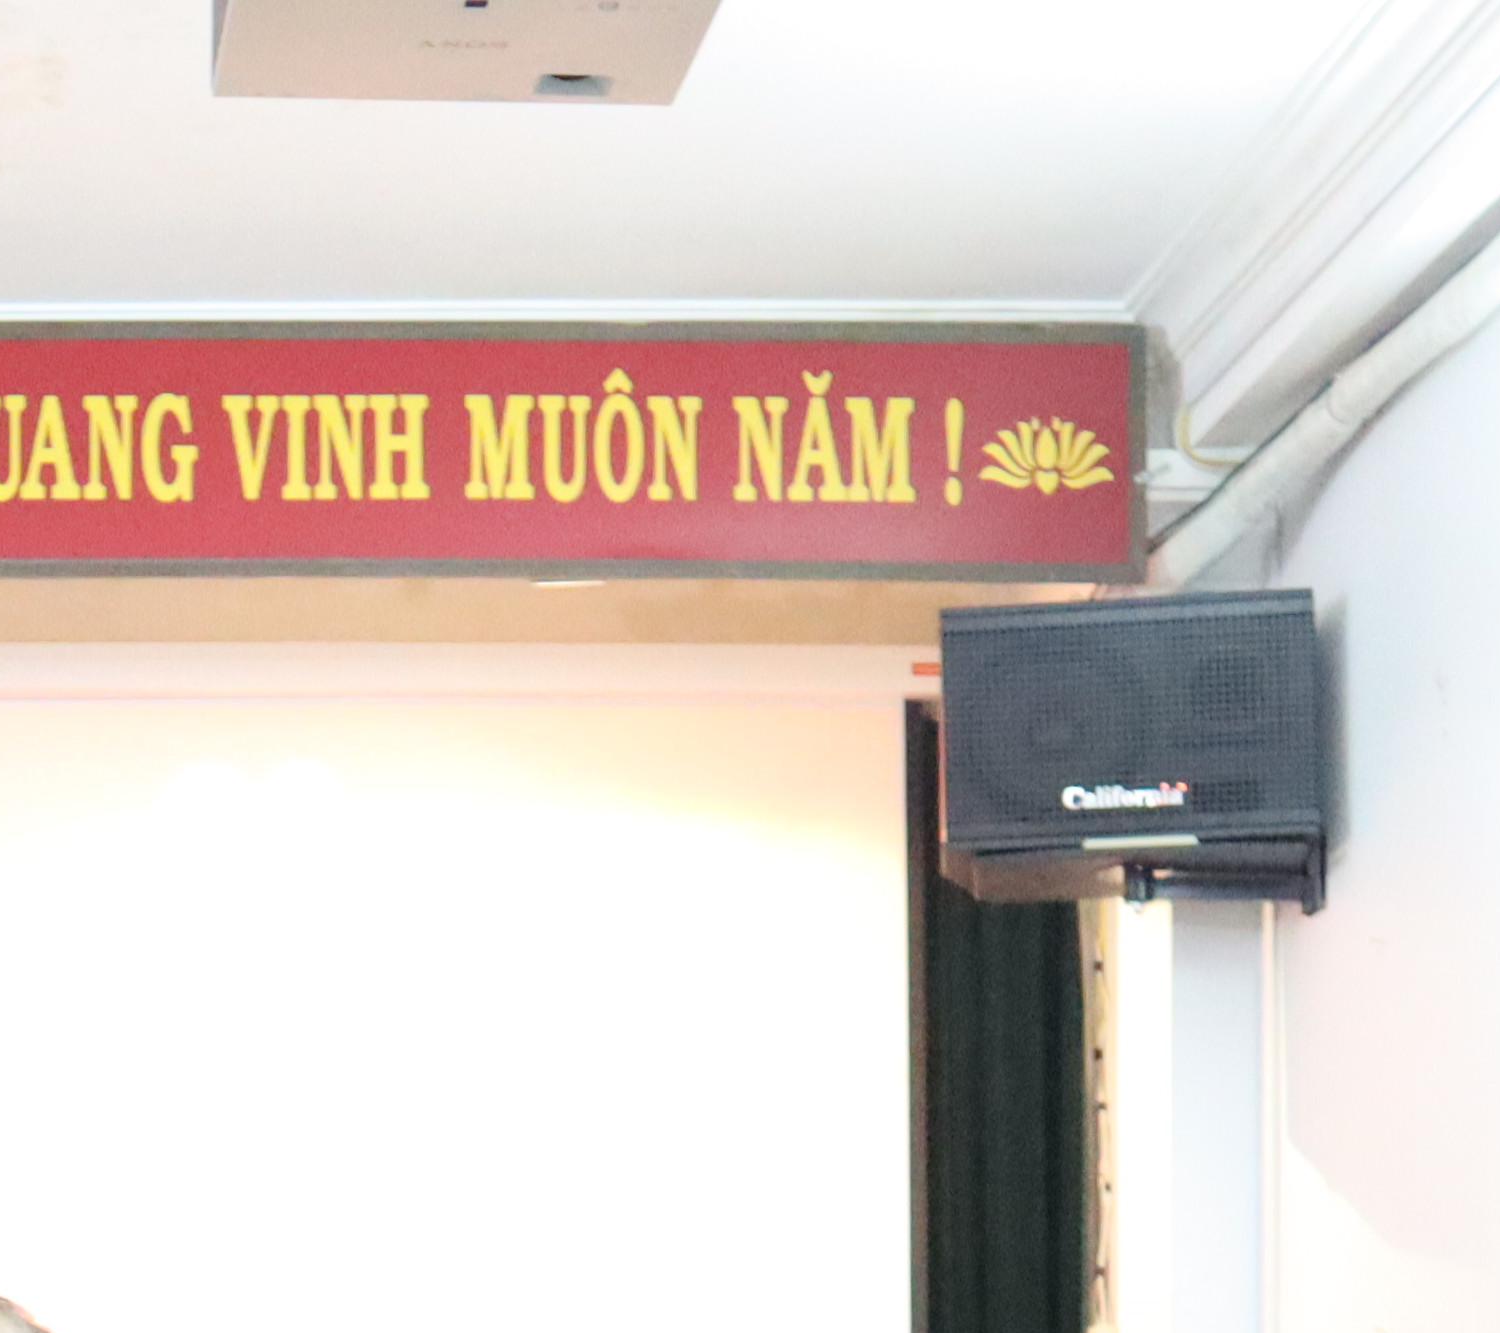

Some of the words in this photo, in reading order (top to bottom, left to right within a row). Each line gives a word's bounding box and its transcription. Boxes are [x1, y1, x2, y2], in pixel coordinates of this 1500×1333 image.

[221, 393, 431, 501] VINH
[463, 368, 703, 504] MUÔN
[732, 369, 917, 504] NĂM
[1061, 782, 1188, 810] California
